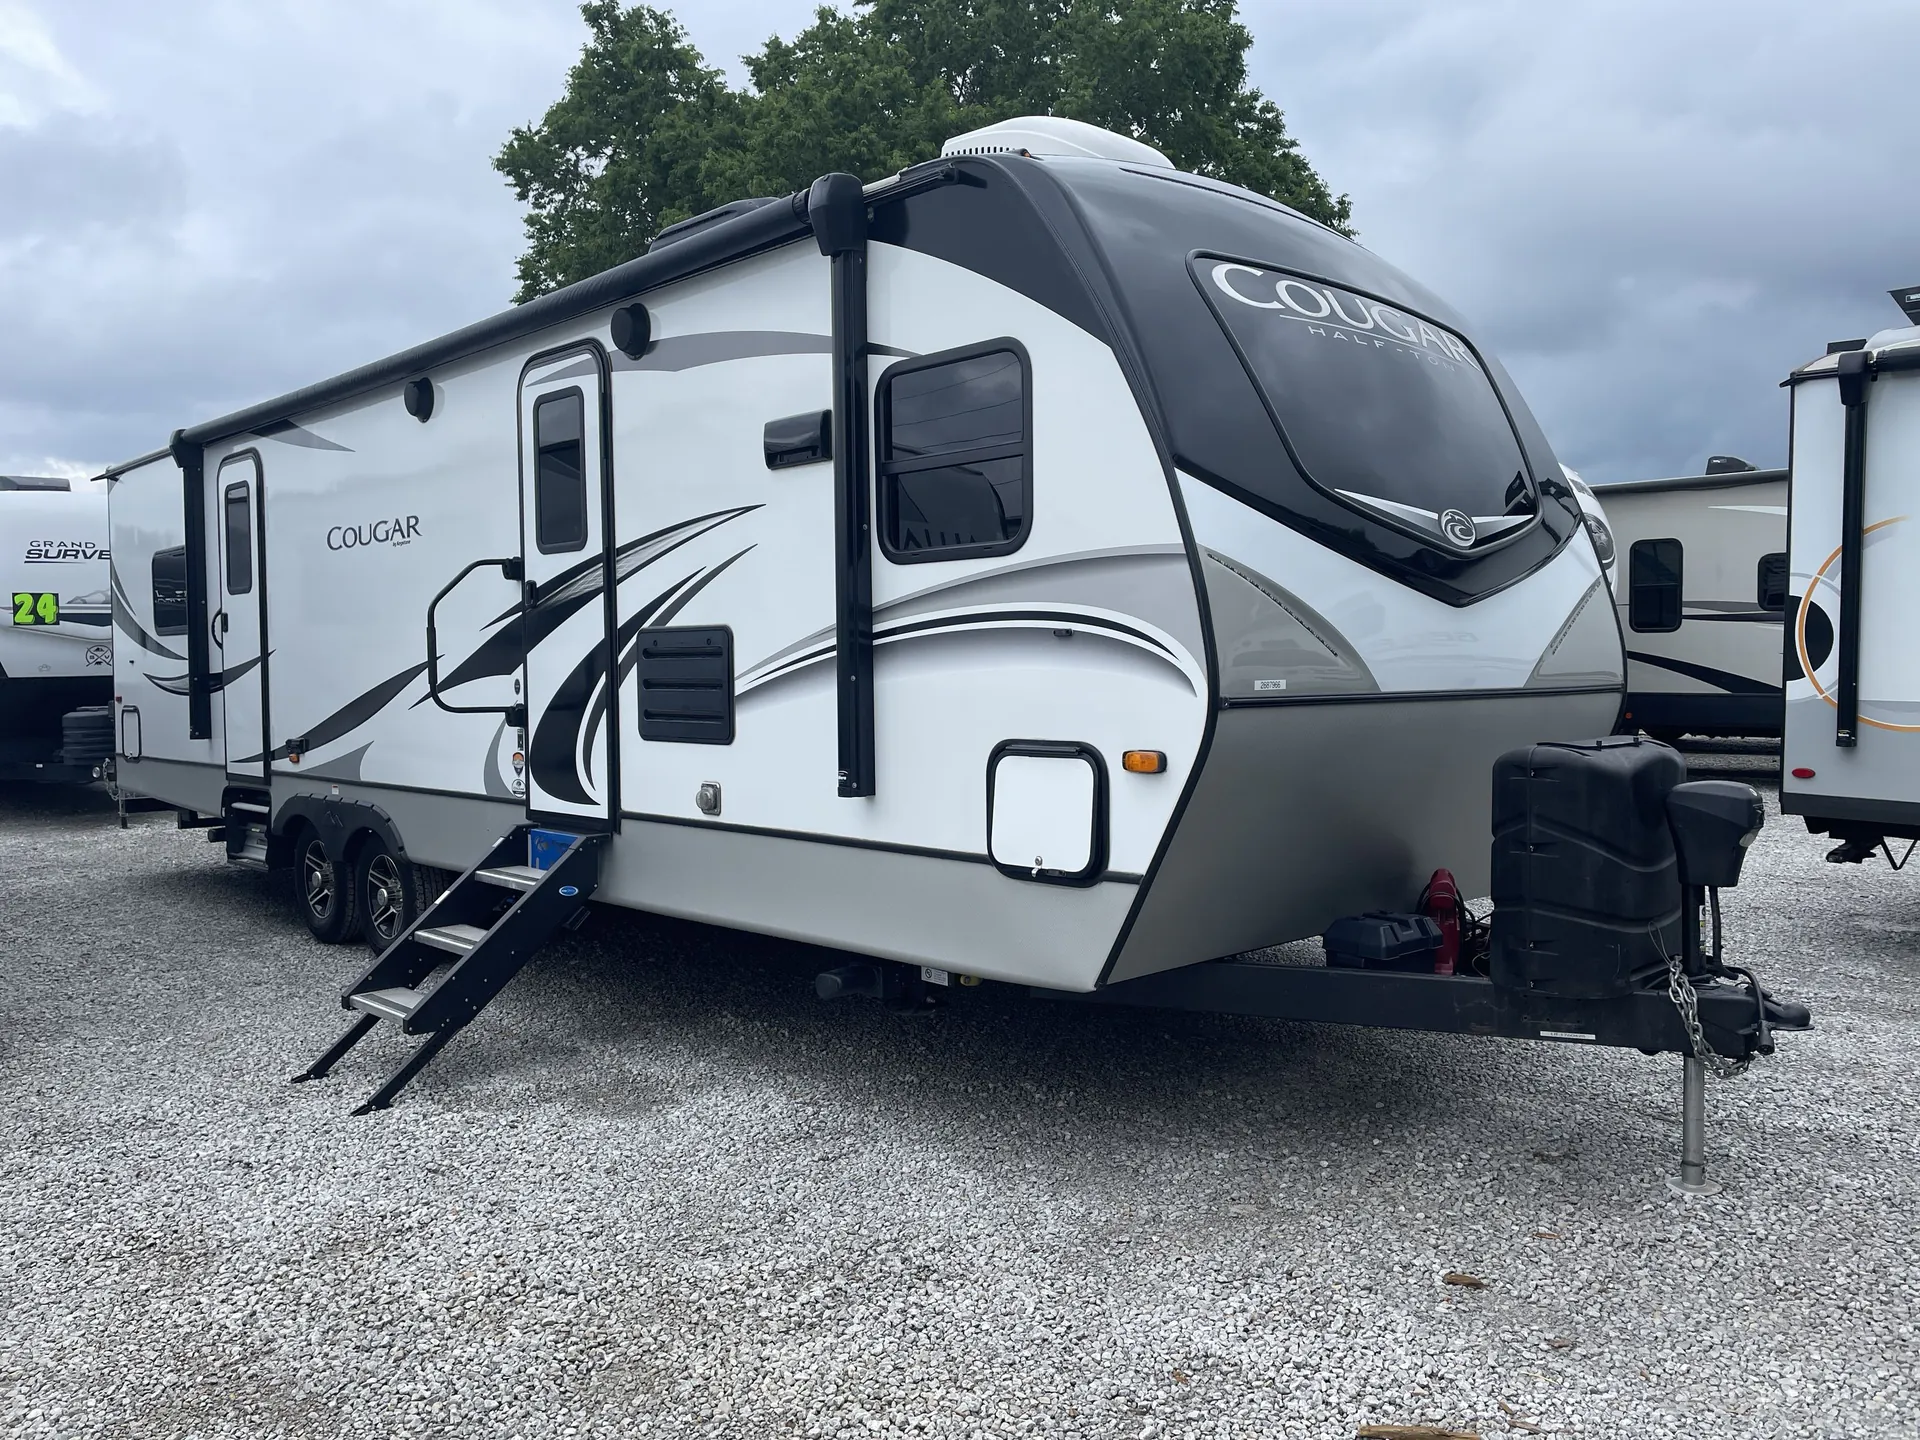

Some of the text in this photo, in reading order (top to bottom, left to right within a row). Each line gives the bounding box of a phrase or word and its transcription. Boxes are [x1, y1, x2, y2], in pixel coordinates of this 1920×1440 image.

[1211, 263, 1481, 372] COUGAR
[29, 540, 96, 549] GRAND
[326, 515, 423, 551] COUGAR
[25, 549, 111, 560] SURVE
[13, 592, 59, 624] 24
